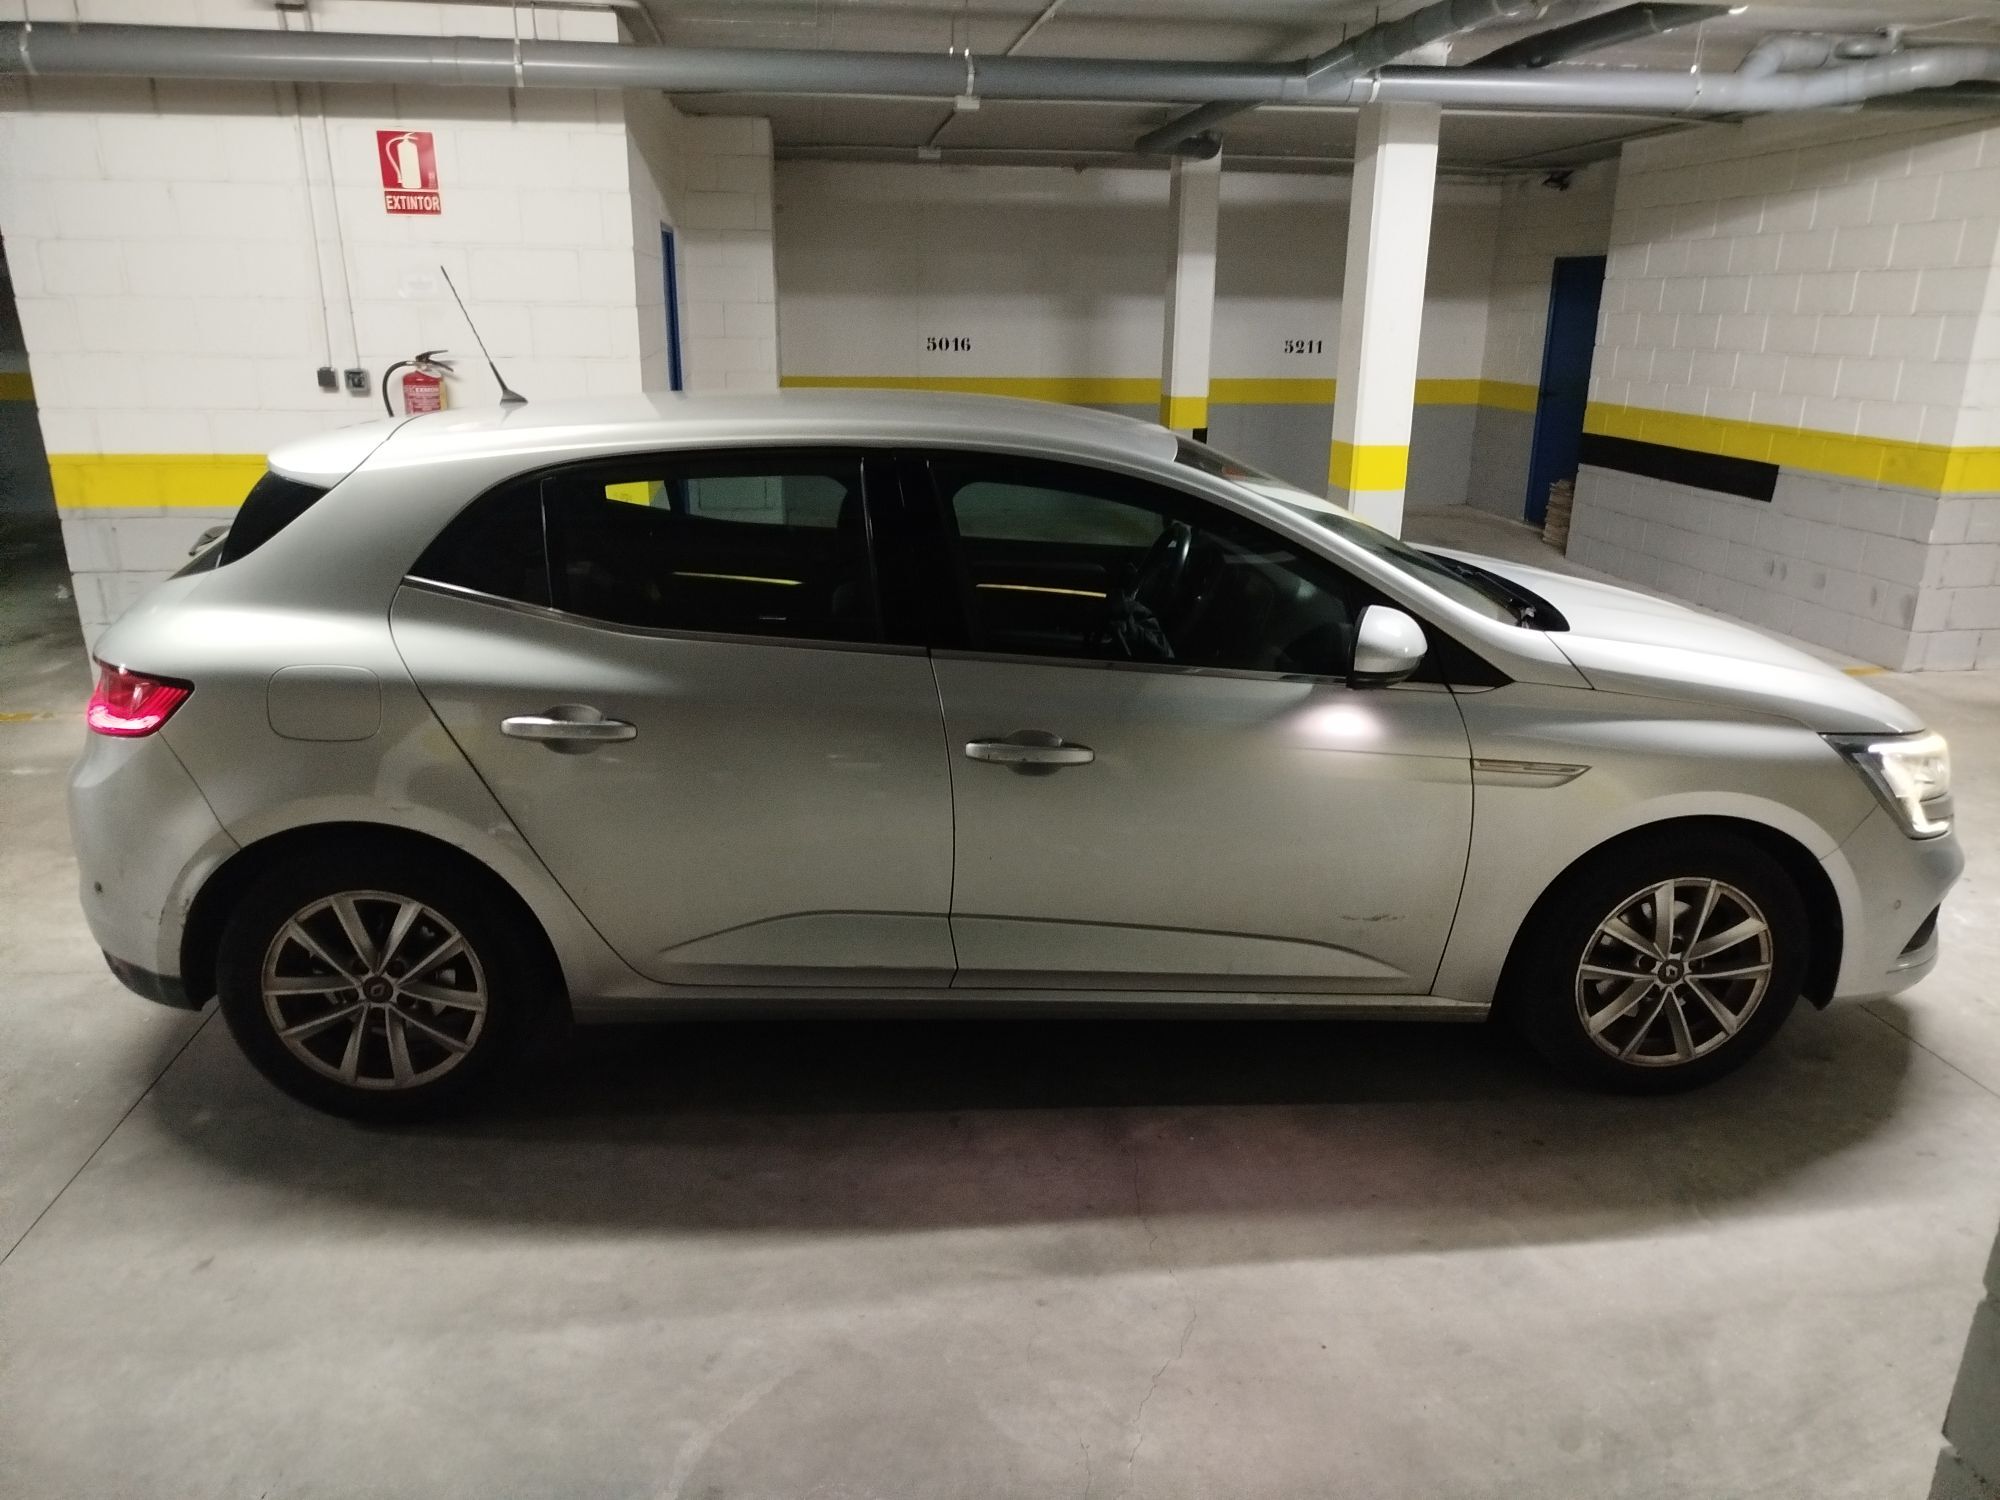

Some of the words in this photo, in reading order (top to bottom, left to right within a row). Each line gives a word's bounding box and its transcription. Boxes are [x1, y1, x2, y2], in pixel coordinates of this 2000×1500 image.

[385, 195, 440, 211] EXTINTOR
[926, 337, 971, 352] 5016
[1284, 339, 1322, 354] 5211
